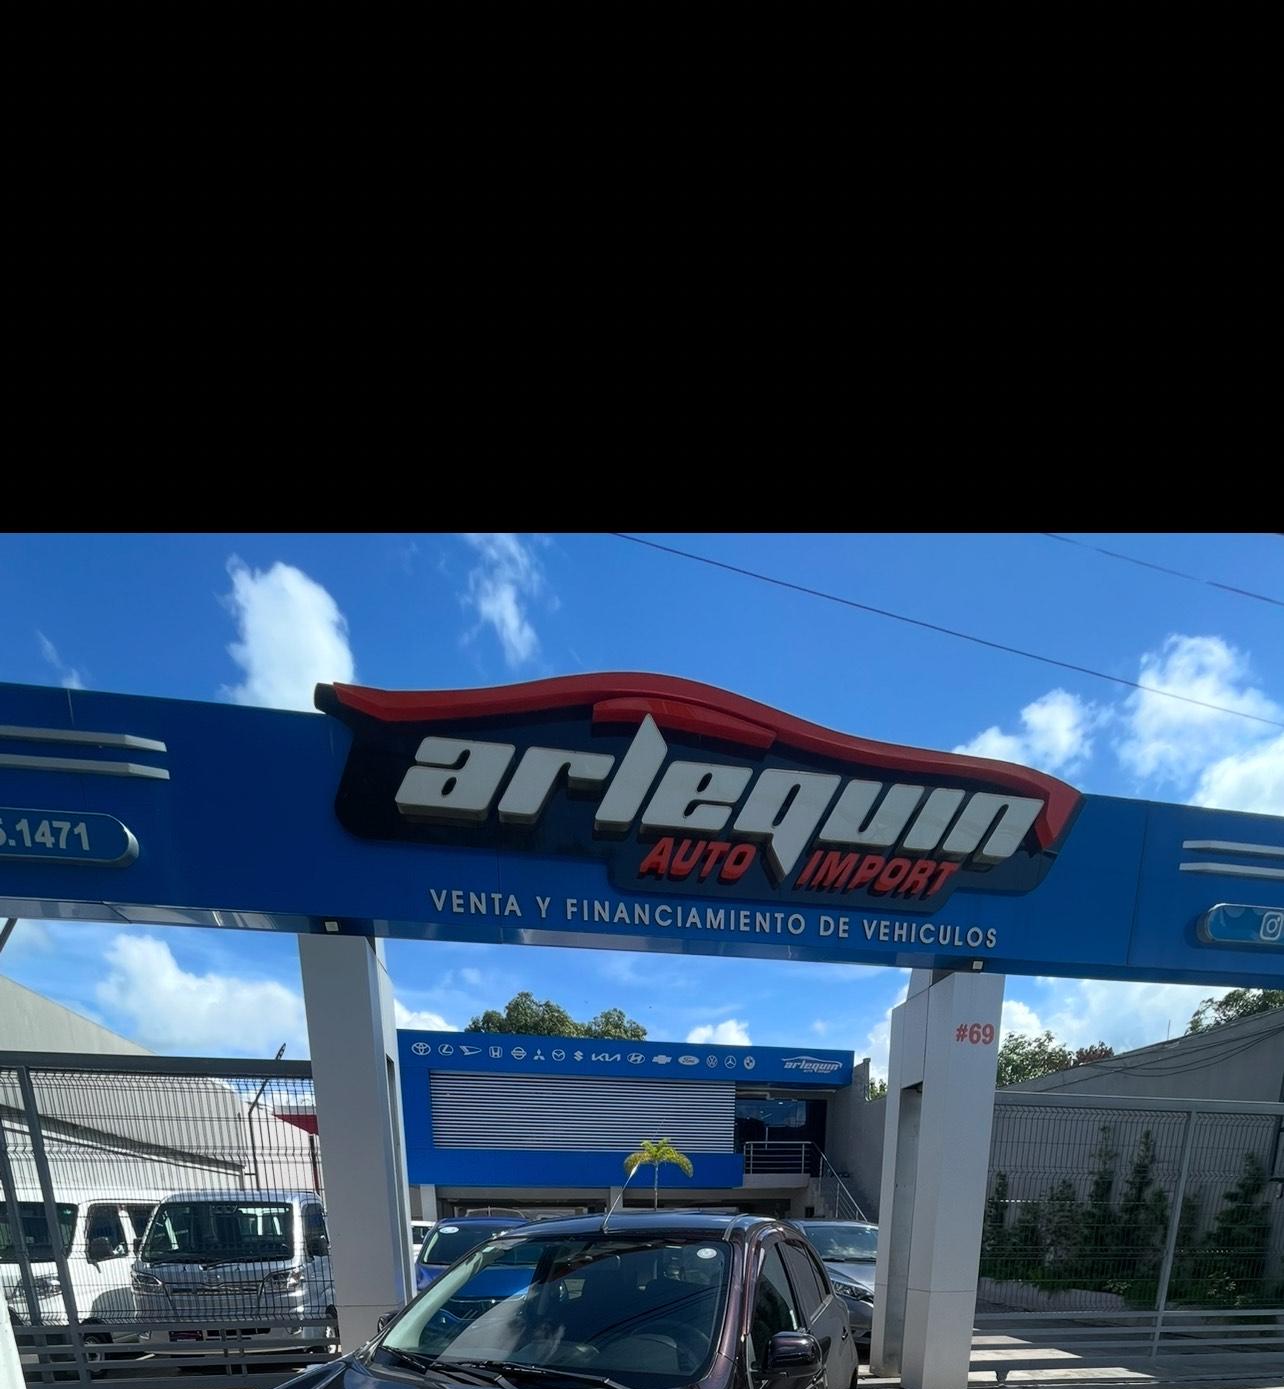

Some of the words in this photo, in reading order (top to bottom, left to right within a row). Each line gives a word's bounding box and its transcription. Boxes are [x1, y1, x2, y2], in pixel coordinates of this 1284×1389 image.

[394, 713, 1046, 877] arlequin
[638, 836, 757, 883] AUTO
[797, 850, 960, 898] IMPORT
[429, 888, 523, 917] VENTA
[536, 896, 551, 919] Y
[566, 898, 806, 936] FINANCIAMIENTO
[819, 915, 849, 938] DE
[863, 919, 998, 949] VEHICULOS
[955, 1023, 996, 1045] #69
